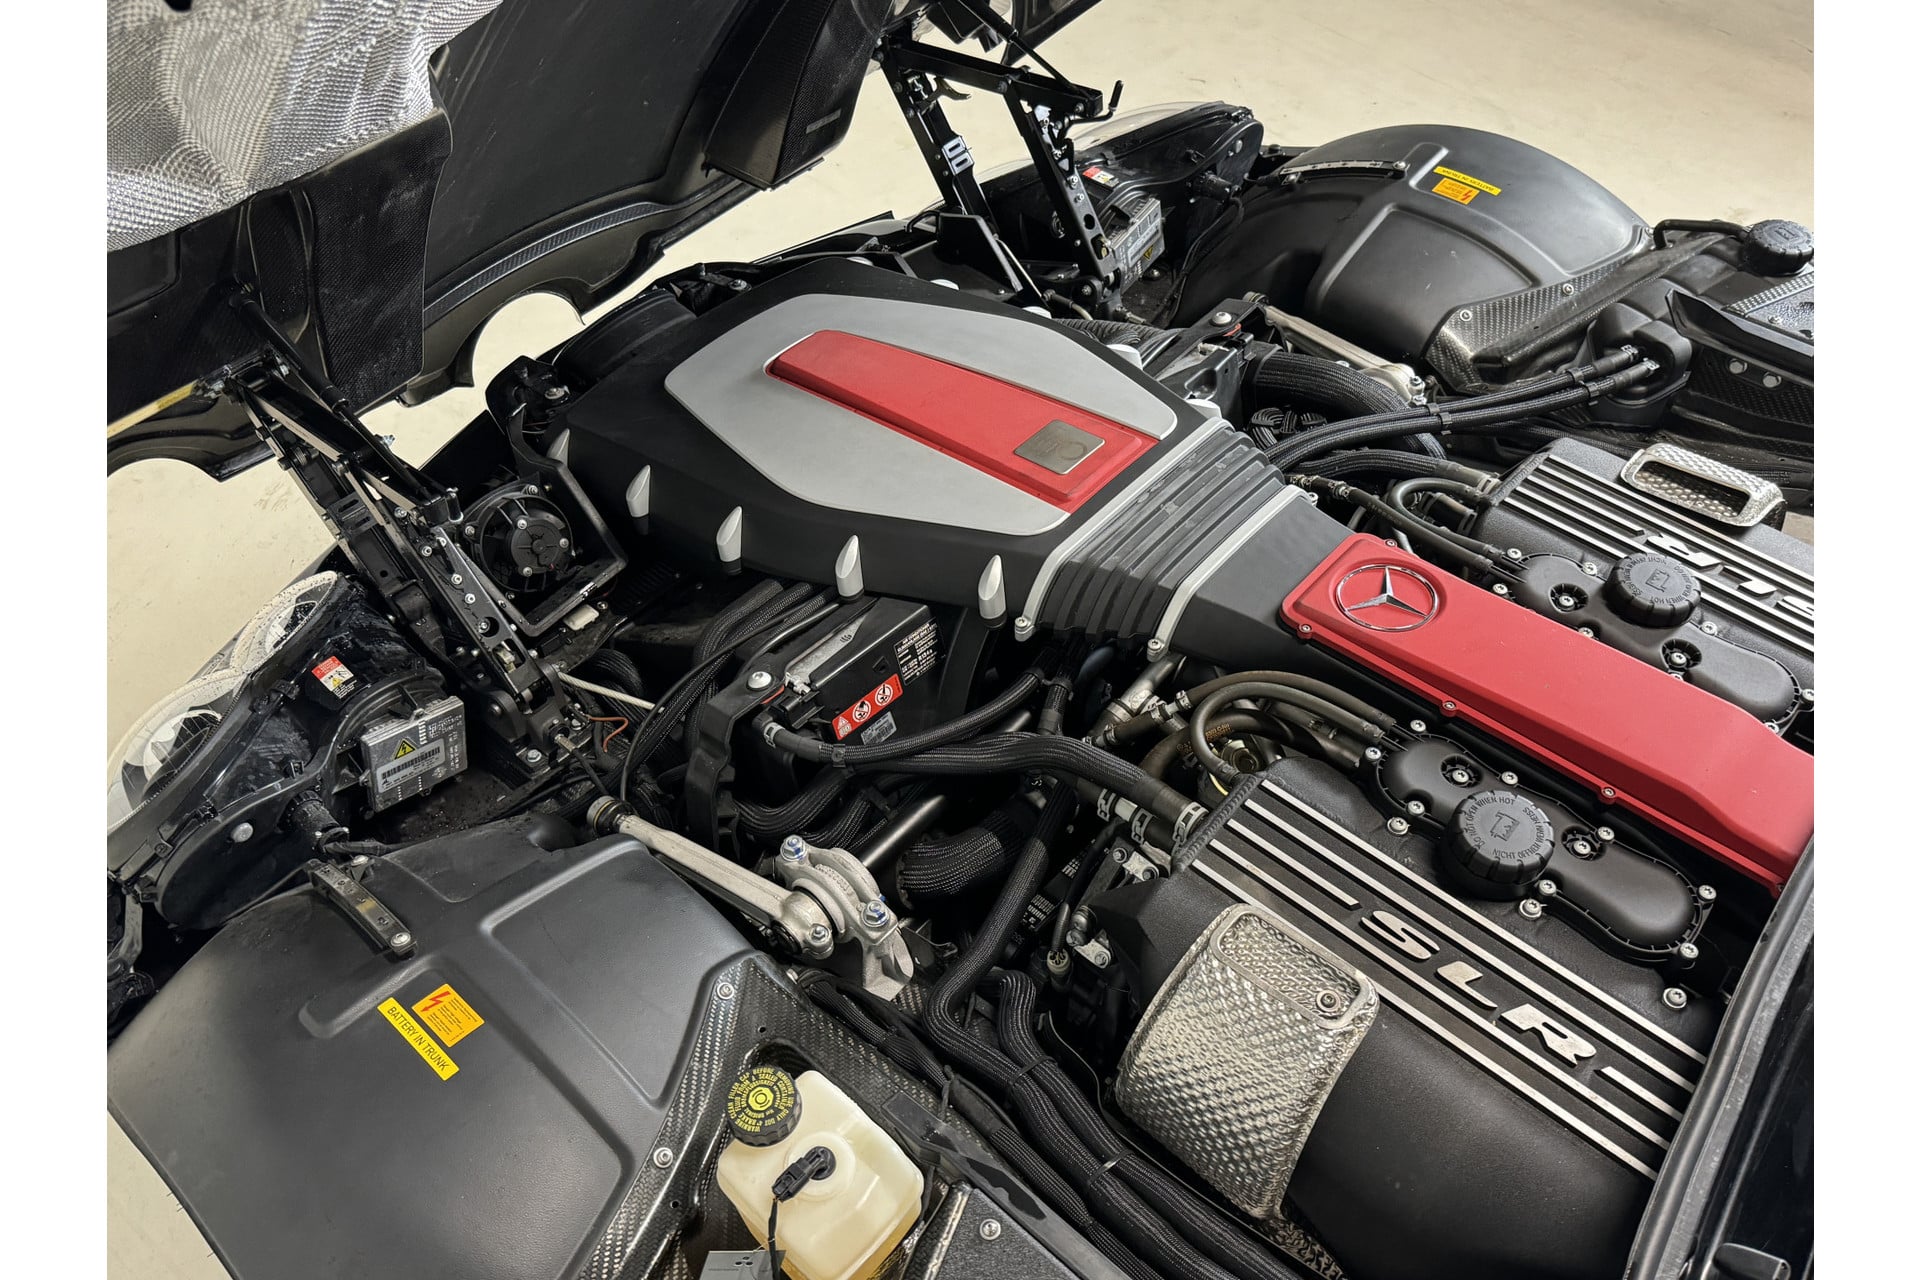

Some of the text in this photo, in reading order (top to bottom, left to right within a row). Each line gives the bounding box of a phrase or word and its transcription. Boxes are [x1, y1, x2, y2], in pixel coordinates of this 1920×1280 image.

[1498, 796, 1516, 805] HOT
[1492, 848, 1516, 859] NICHT
[1360, 910, 1597, 1065] SLR
[387, 1006, 418, 1037] BATTERY
[413, 1034, 425, 1047] IN
[422, 1042, 451, 1071] TRUNK
[740, 1072, 750, 1080] CAP
[728, 1102, 736, 1118] CLEAN
[735, 1118, 760, 1131] WARNING
[765, 1118, 775, 1126] DOT
